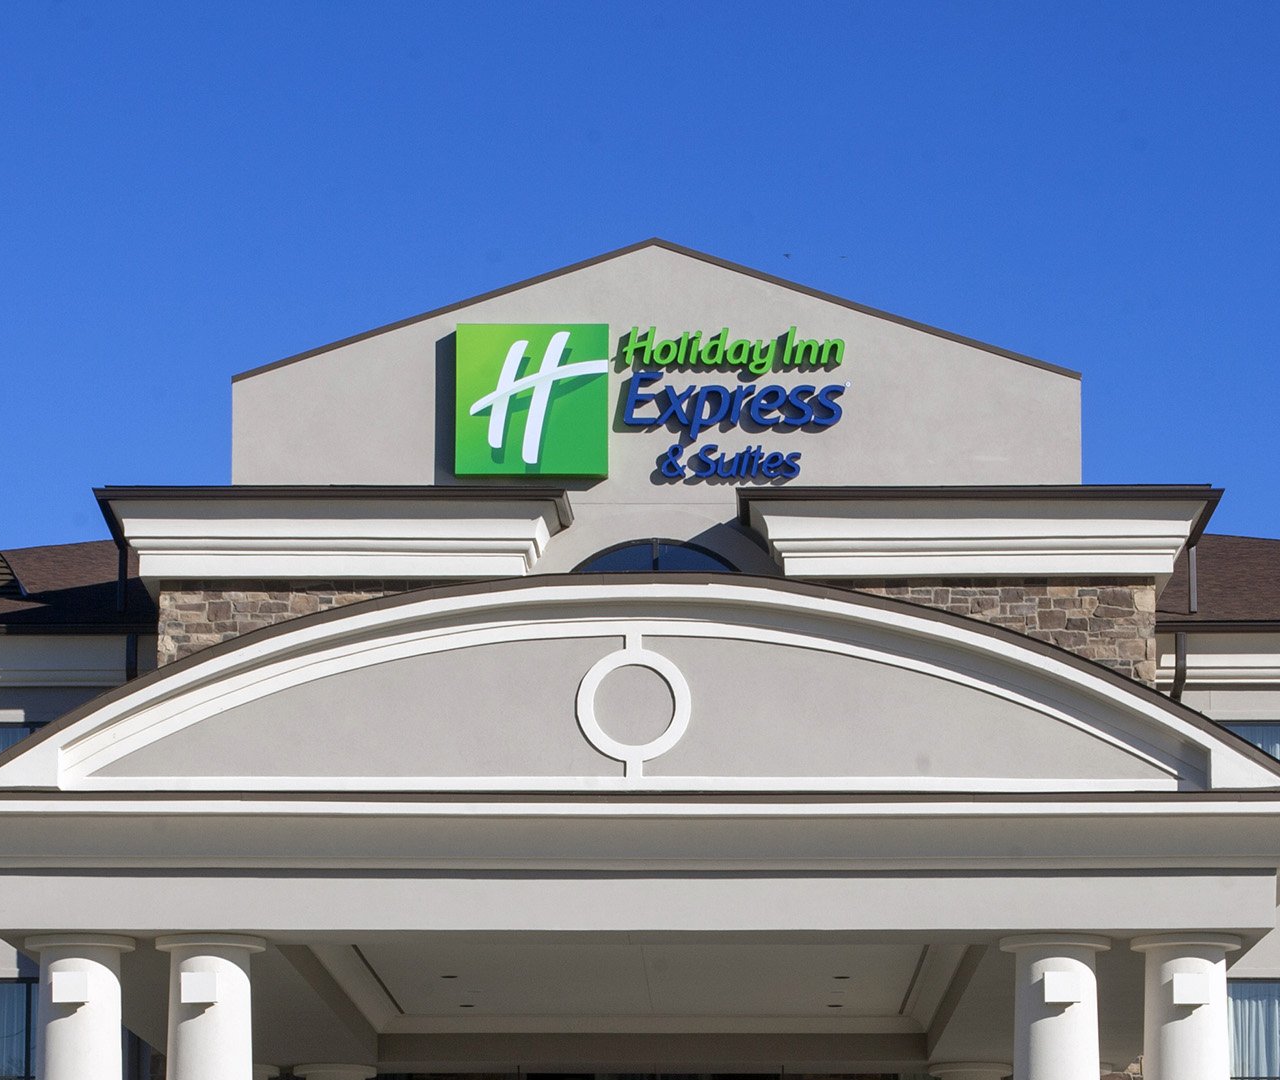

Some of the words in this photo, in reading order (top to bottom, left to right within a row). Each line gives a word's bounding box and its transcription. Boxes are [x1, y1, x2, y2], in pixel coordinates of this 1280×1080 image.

[622, 326, 777, 375] Holiday
[783, 326, 846, 365] Inn
[623, 371, 846, 441] Express
[660, 443, 686, 478] &
[694, 443, 802, 478] Suites
